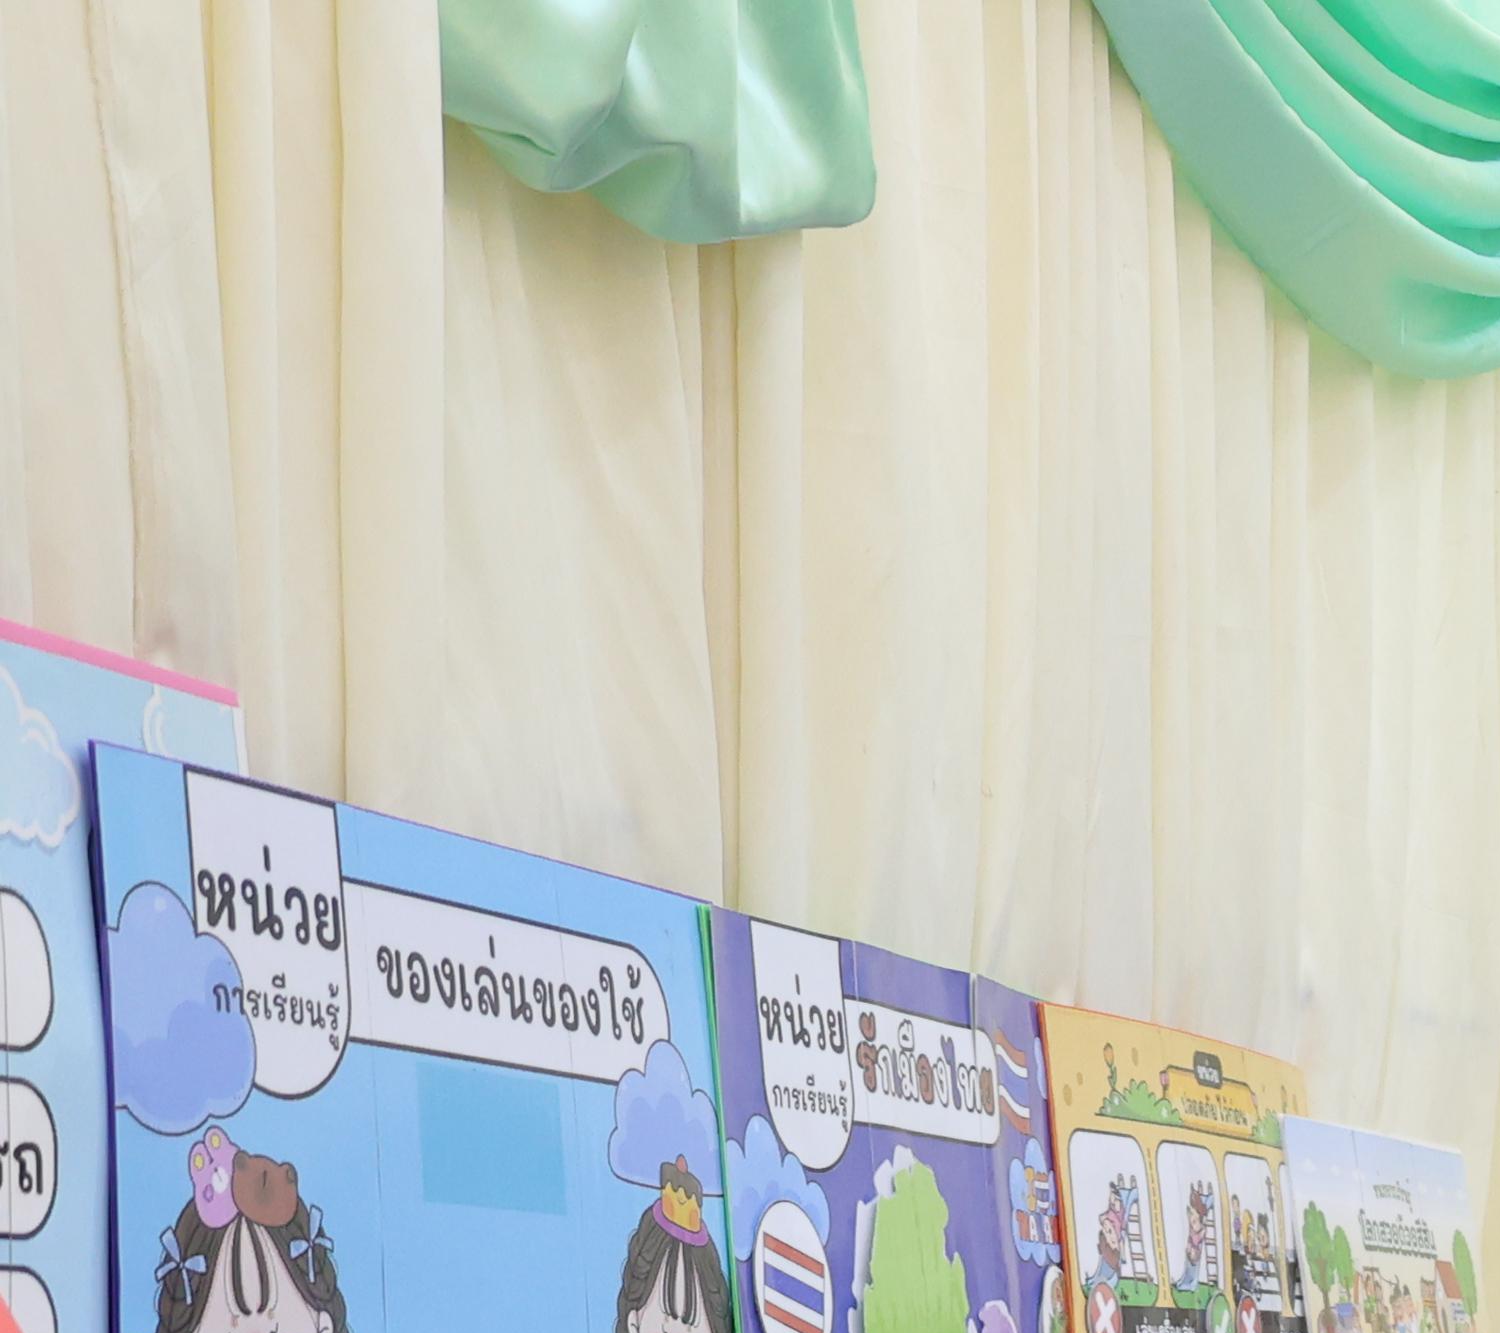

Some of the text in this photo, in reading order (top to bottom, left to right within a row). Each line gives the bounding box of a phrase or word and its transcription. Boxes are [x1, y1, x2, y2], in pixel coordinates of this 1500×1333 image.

[199, 847, 342, 952] หน่วย
[213, 976, 341, 1051] การเรียนรู้
[378, 937, 645, 1044] ของเล่นของใช้
[760, 974, 845, 1053] หน่วย
[773, 1075, 849, 1133] การเรียนรู้
[856, 1012, 995, 1116] รักเมืองไทย
